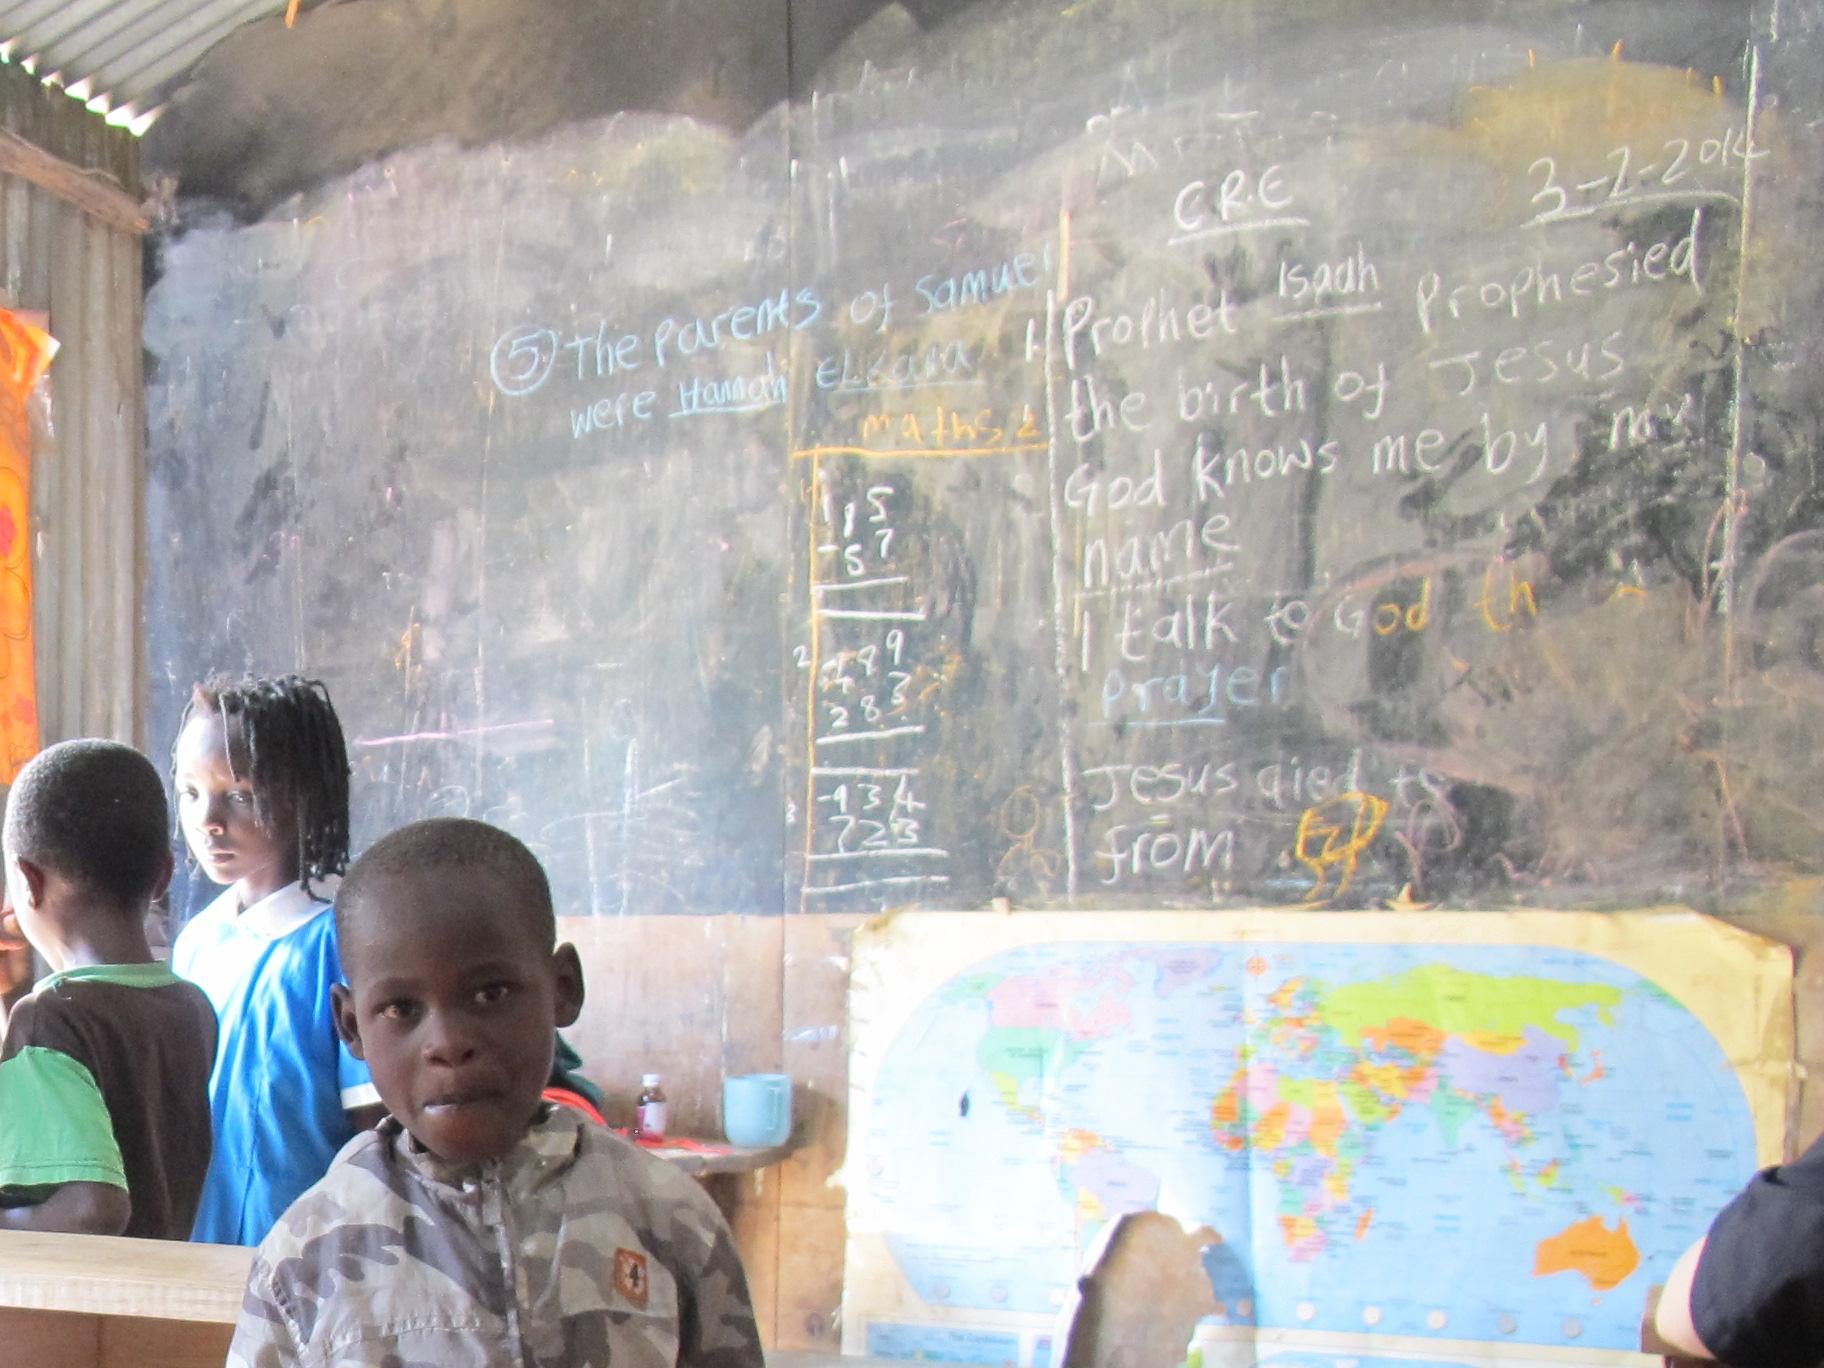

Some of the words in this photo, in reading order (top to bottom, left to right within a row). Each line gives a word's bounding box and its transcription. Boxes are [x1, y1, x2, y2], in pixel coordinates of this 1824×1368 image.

[563, 320, 640, 380] The
[569, 389, 657, 438] were
[1064, 374, 1152, 442] the
[1178, 353, 1308, 422] birth
[1334, 360, 1391, 420] of
[1427, 330, 1626, 397] Jesus
[1064, 447, 1168, 517] God
[1372, 431, 1444, 476] me
[1480, 410, 1549, 485] by
[1083, 514, 1240, 590] name
[1082, 762, 1240, 811] Jesus
